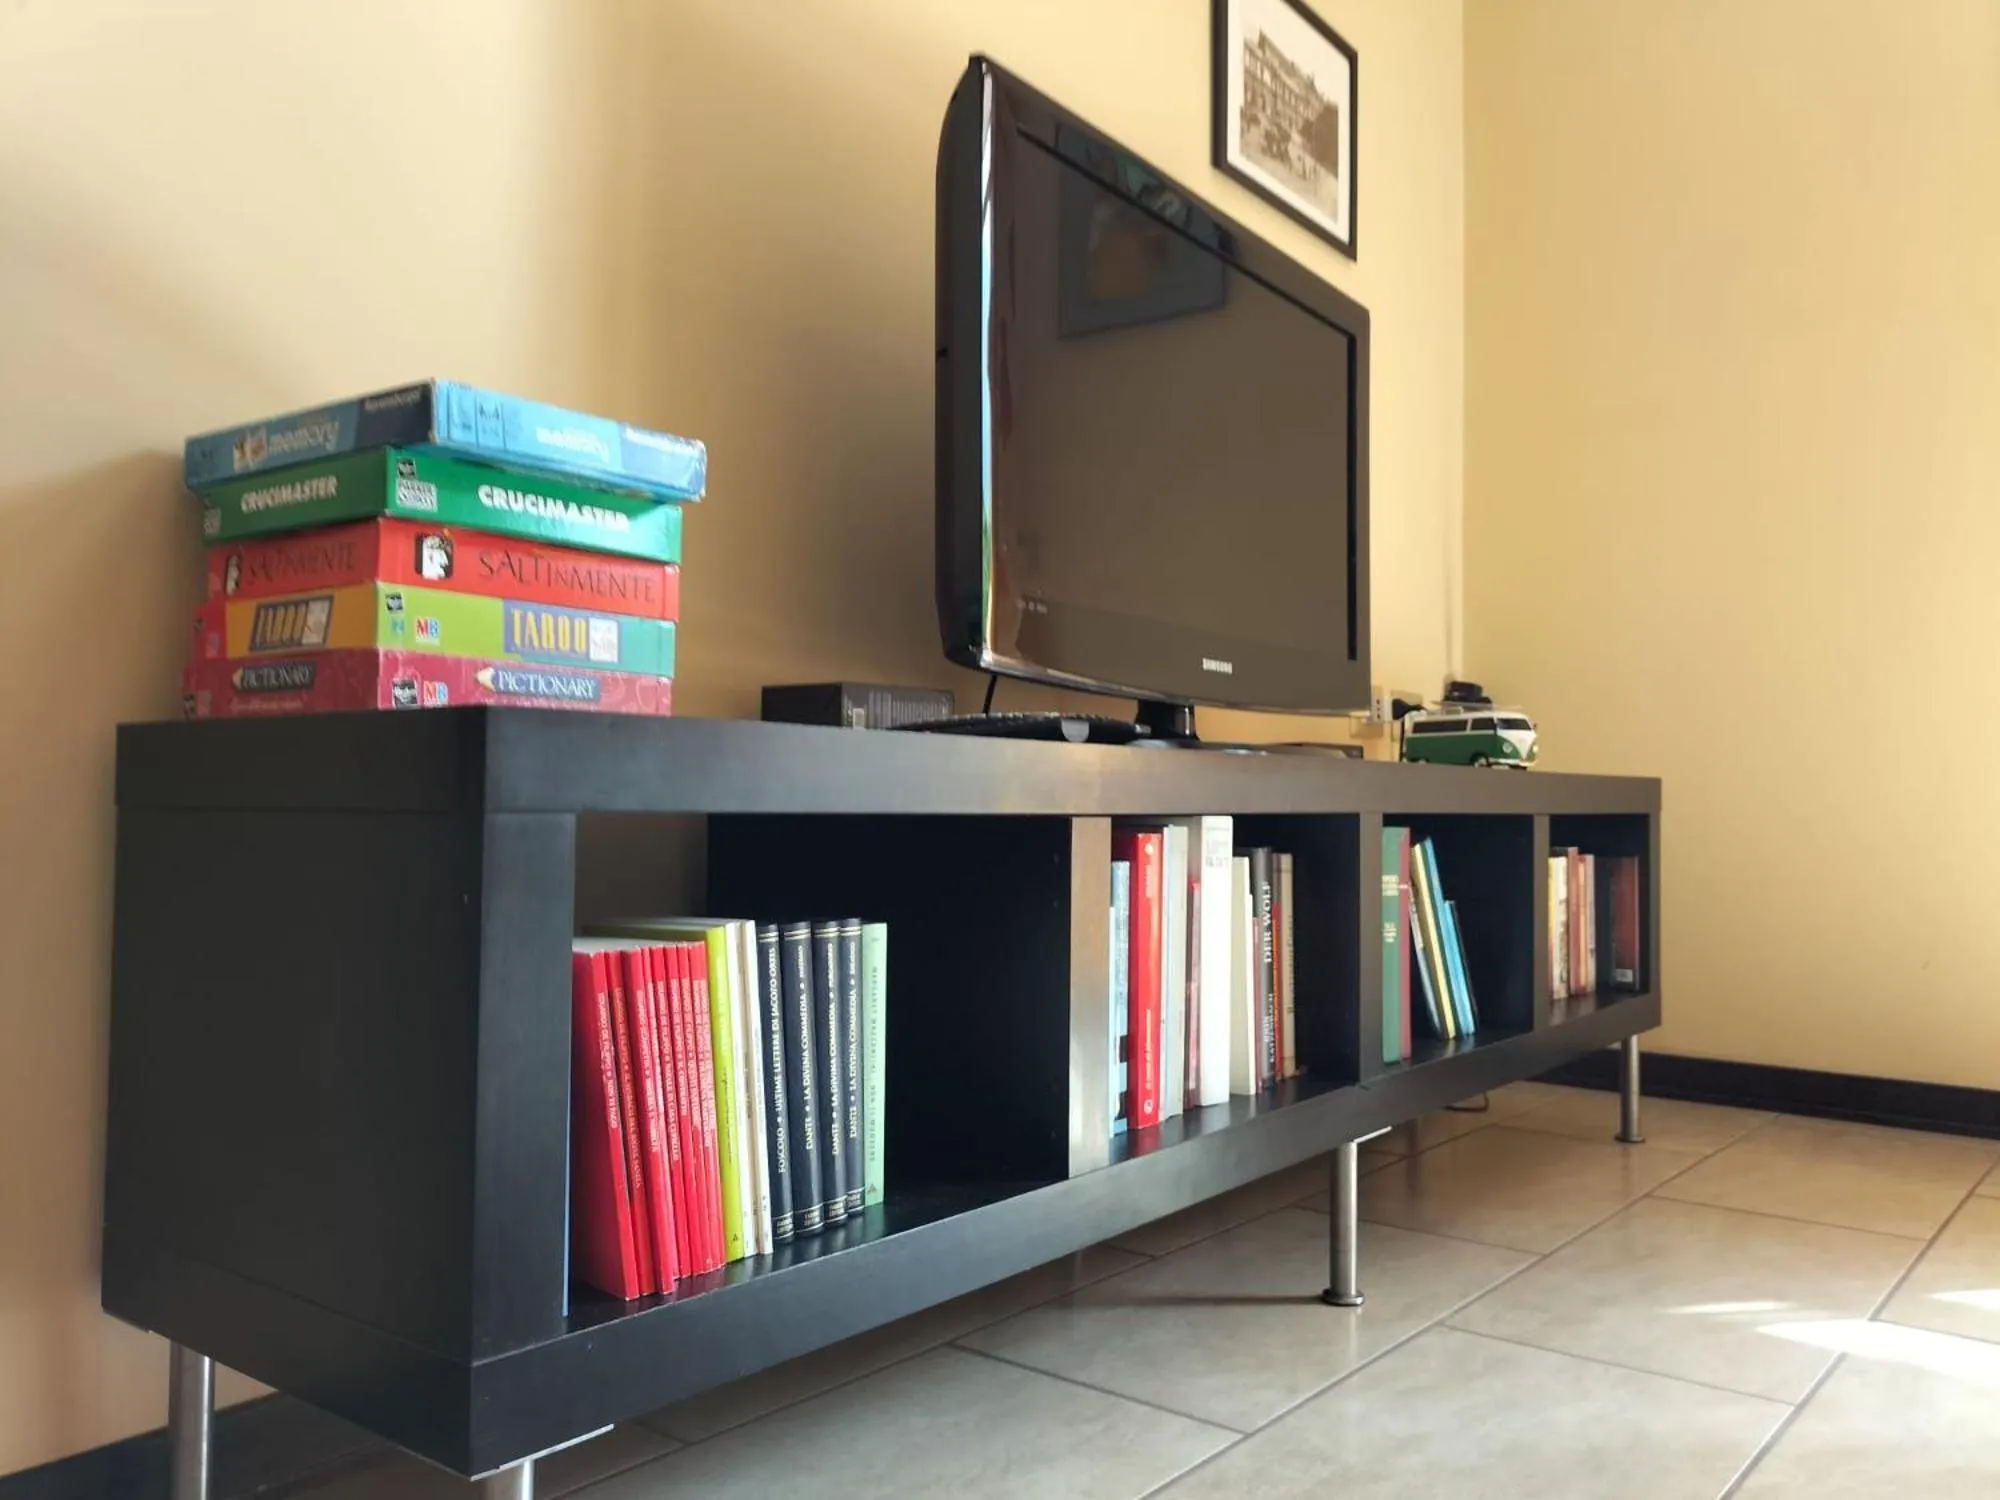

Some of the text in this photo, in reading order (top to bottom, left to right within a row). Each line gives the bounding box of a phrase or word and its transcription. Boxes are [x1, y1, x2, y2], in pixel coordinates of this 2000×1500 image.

[241, 475, 338, 513] CRUCIMASTER
[478, 484, 631, 533] CRUCIMASTER
[511, 608, 587, 653] TABOO
[1202, 657, 1233, 675] SAMSUNG
[498, 670, 596, 698] PICTIONARY
[1261, 880, 1272, 962] DER WOLF
[768, 947, 777, 977] ORTIS
[770, 1018, 779, 1031] DI
[799, 993, 809, 1049] COMMEDIA
[828, 1002, 837, 1056] COMMEDIA
[848, 989, 857, 1041] COMMEDIA
[771, 1033, 781, 1072] LETTERE
[802, 1050, 811, 1087] DIVINA
[849, 1042, 857, 1077] DIVINA
[773, 1074, 783, 1111] ULTIME
[829, 1058, 838, 1092] DIVINA
[849, 1079, 857, 1091] LA
[803, 1089, 811, 1100] LA
[830, 1093, 838, 1106] LA
[804, 1117, 814, 1150] DANTE
[831, 1123, 839, 1155] DANTE
[849, 1106, 857, 1138] DANTE
[776, 1127, 786, 1174] FOSCOLO
